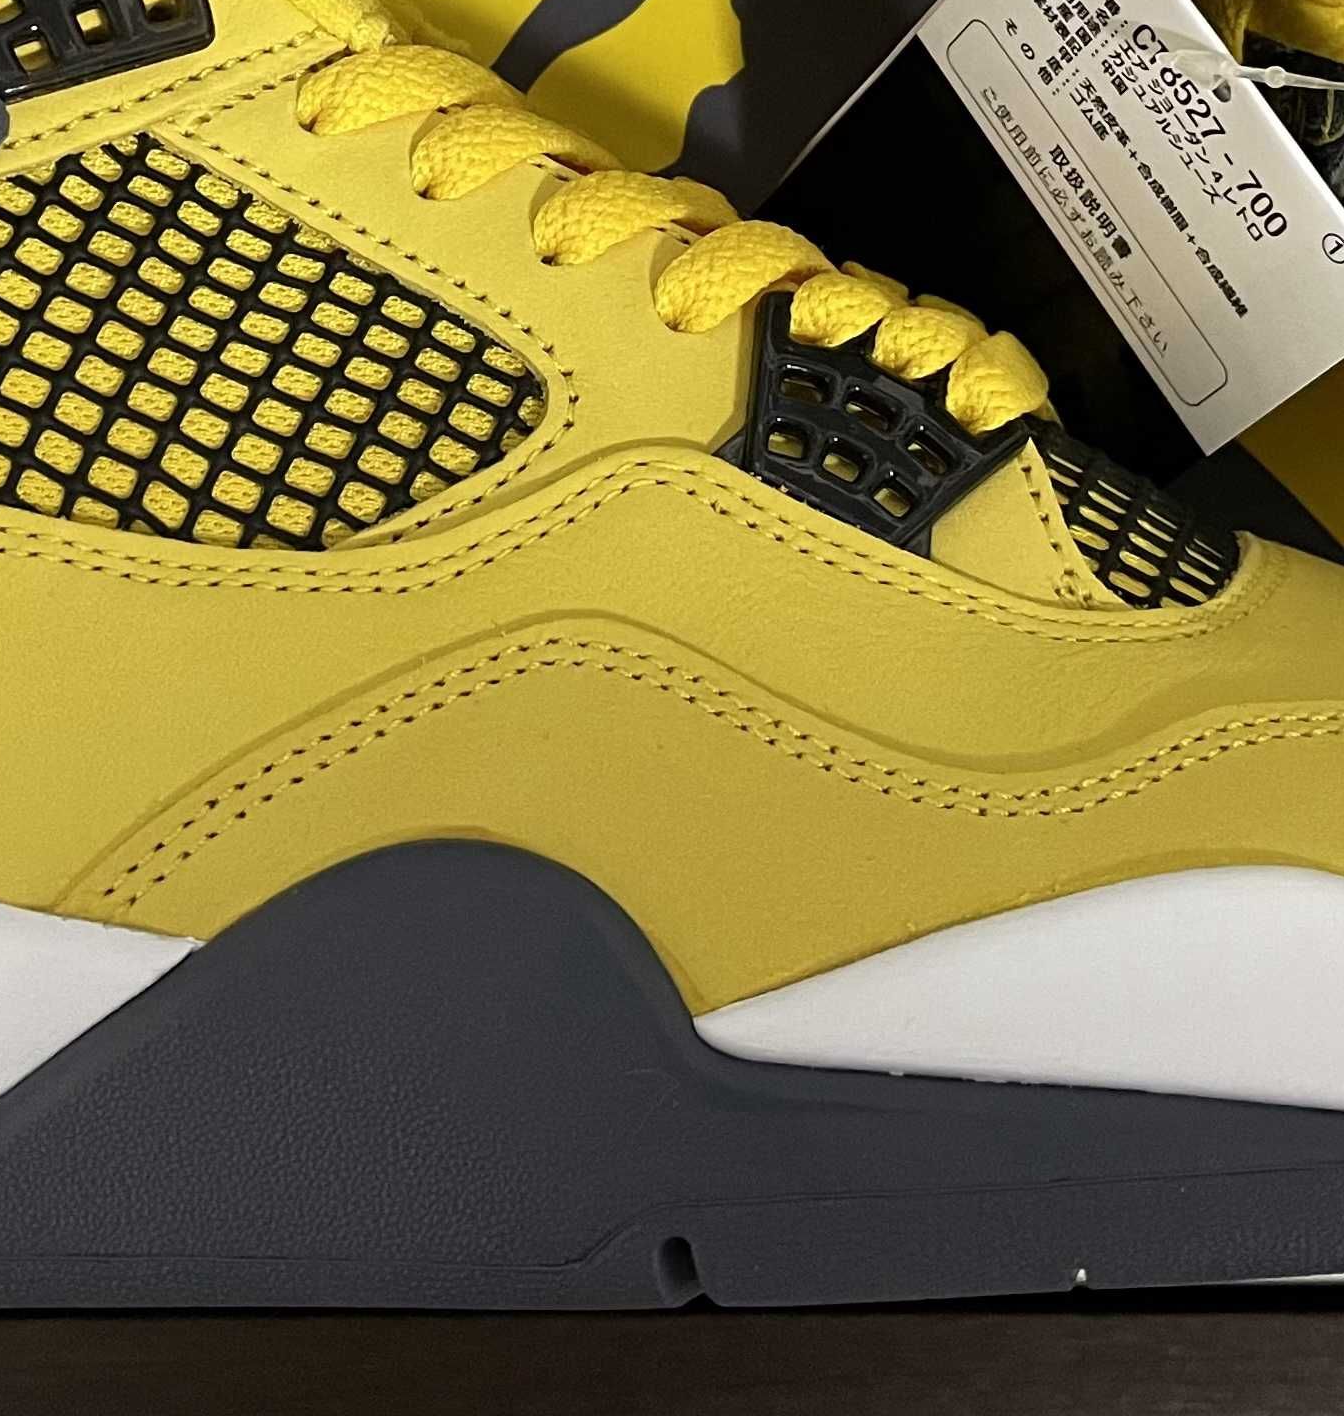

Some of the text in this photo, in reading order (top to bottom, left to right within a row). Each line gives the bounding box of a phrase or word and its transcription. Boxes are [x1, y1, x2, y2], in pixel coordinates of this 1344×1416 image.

[1068, 86, 1111, 142] ゴム底
[1100, 58, 1130, 97] 中国
[1107, 43, 1227, 205] カジュアルシューズ
[982, 85, 1168, 353] ご使用前に必ずお読み下さい
[1048, 143, 1133, 260] 取扱説明書
[1235, 168, 1288, 238] 700
